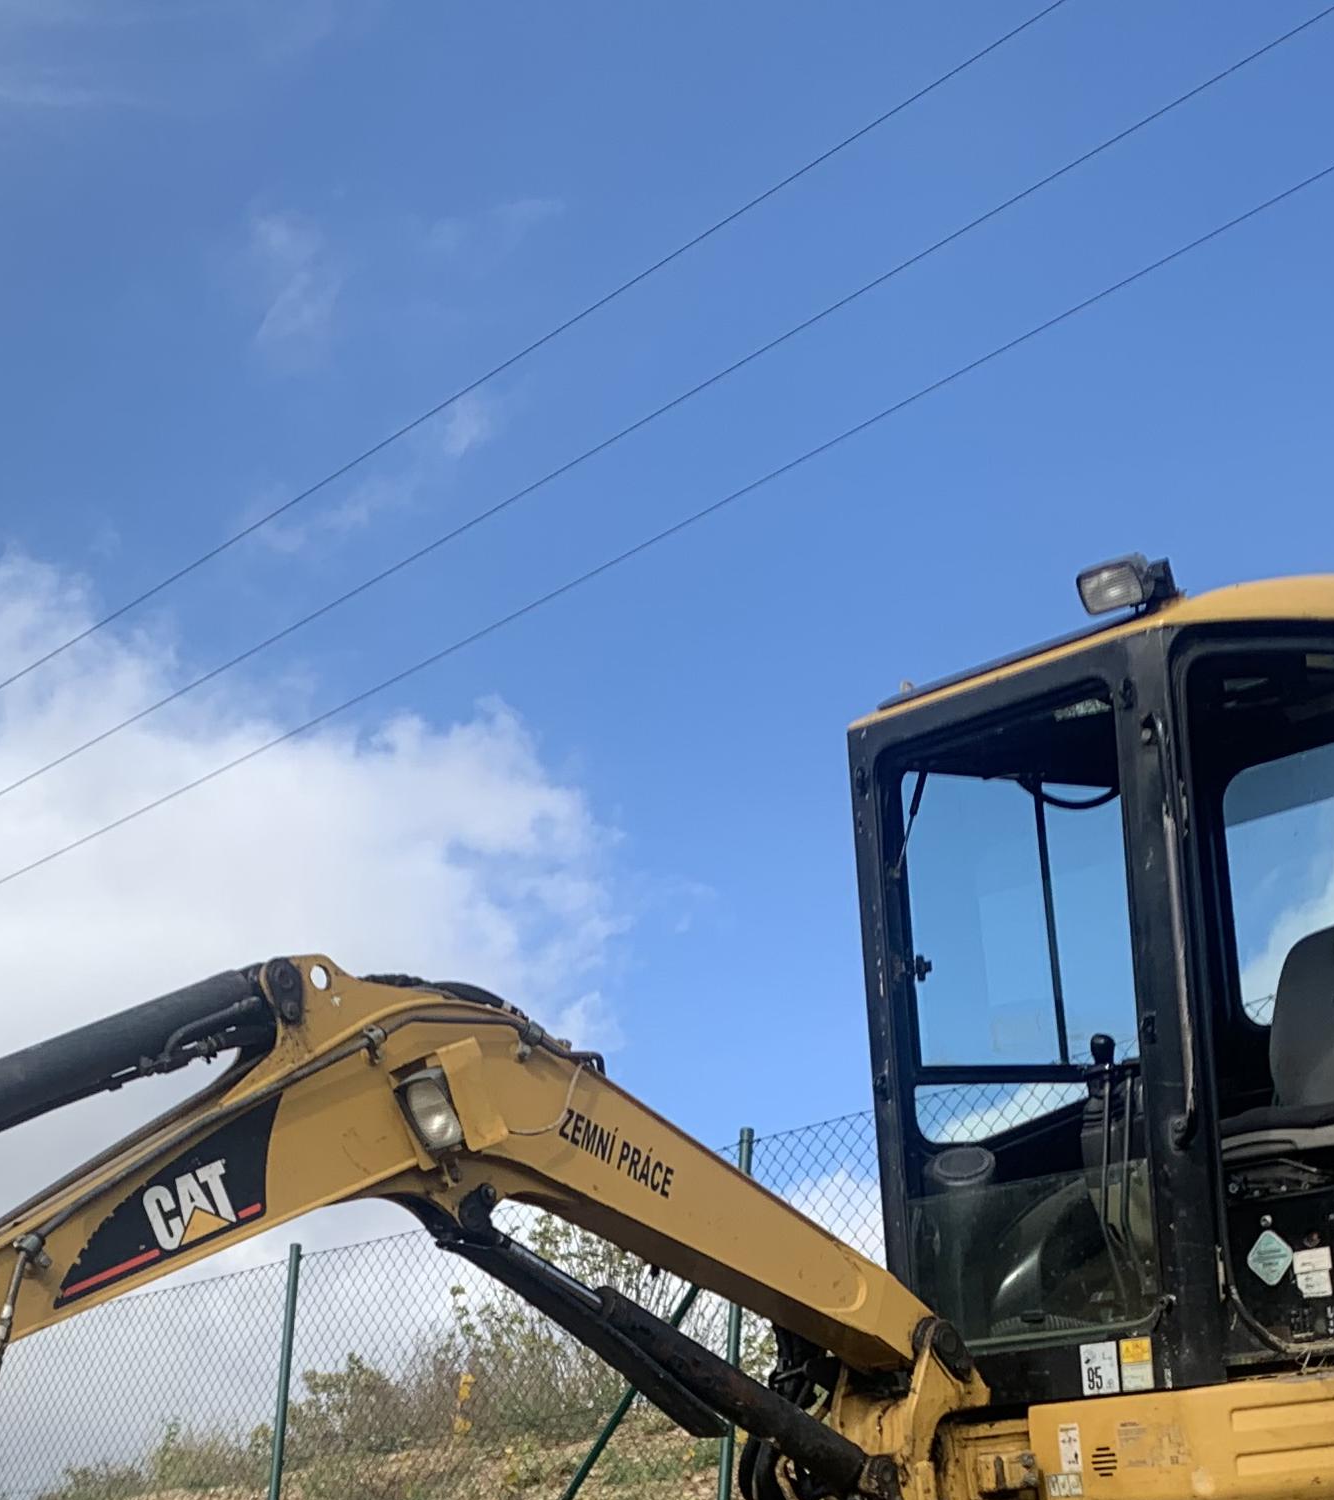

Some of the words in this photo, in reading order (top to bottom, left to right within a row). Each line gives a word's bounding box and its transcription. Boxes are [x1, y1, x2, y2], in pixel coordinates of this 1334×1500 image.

[559, 1107, 619, 1165] ZEMNÍ
[616, 1147, 675, 1200] PRÁCE
[142, 1158, 237, 1251] CAT
[1087, 1366, 1103, 1390] 95
